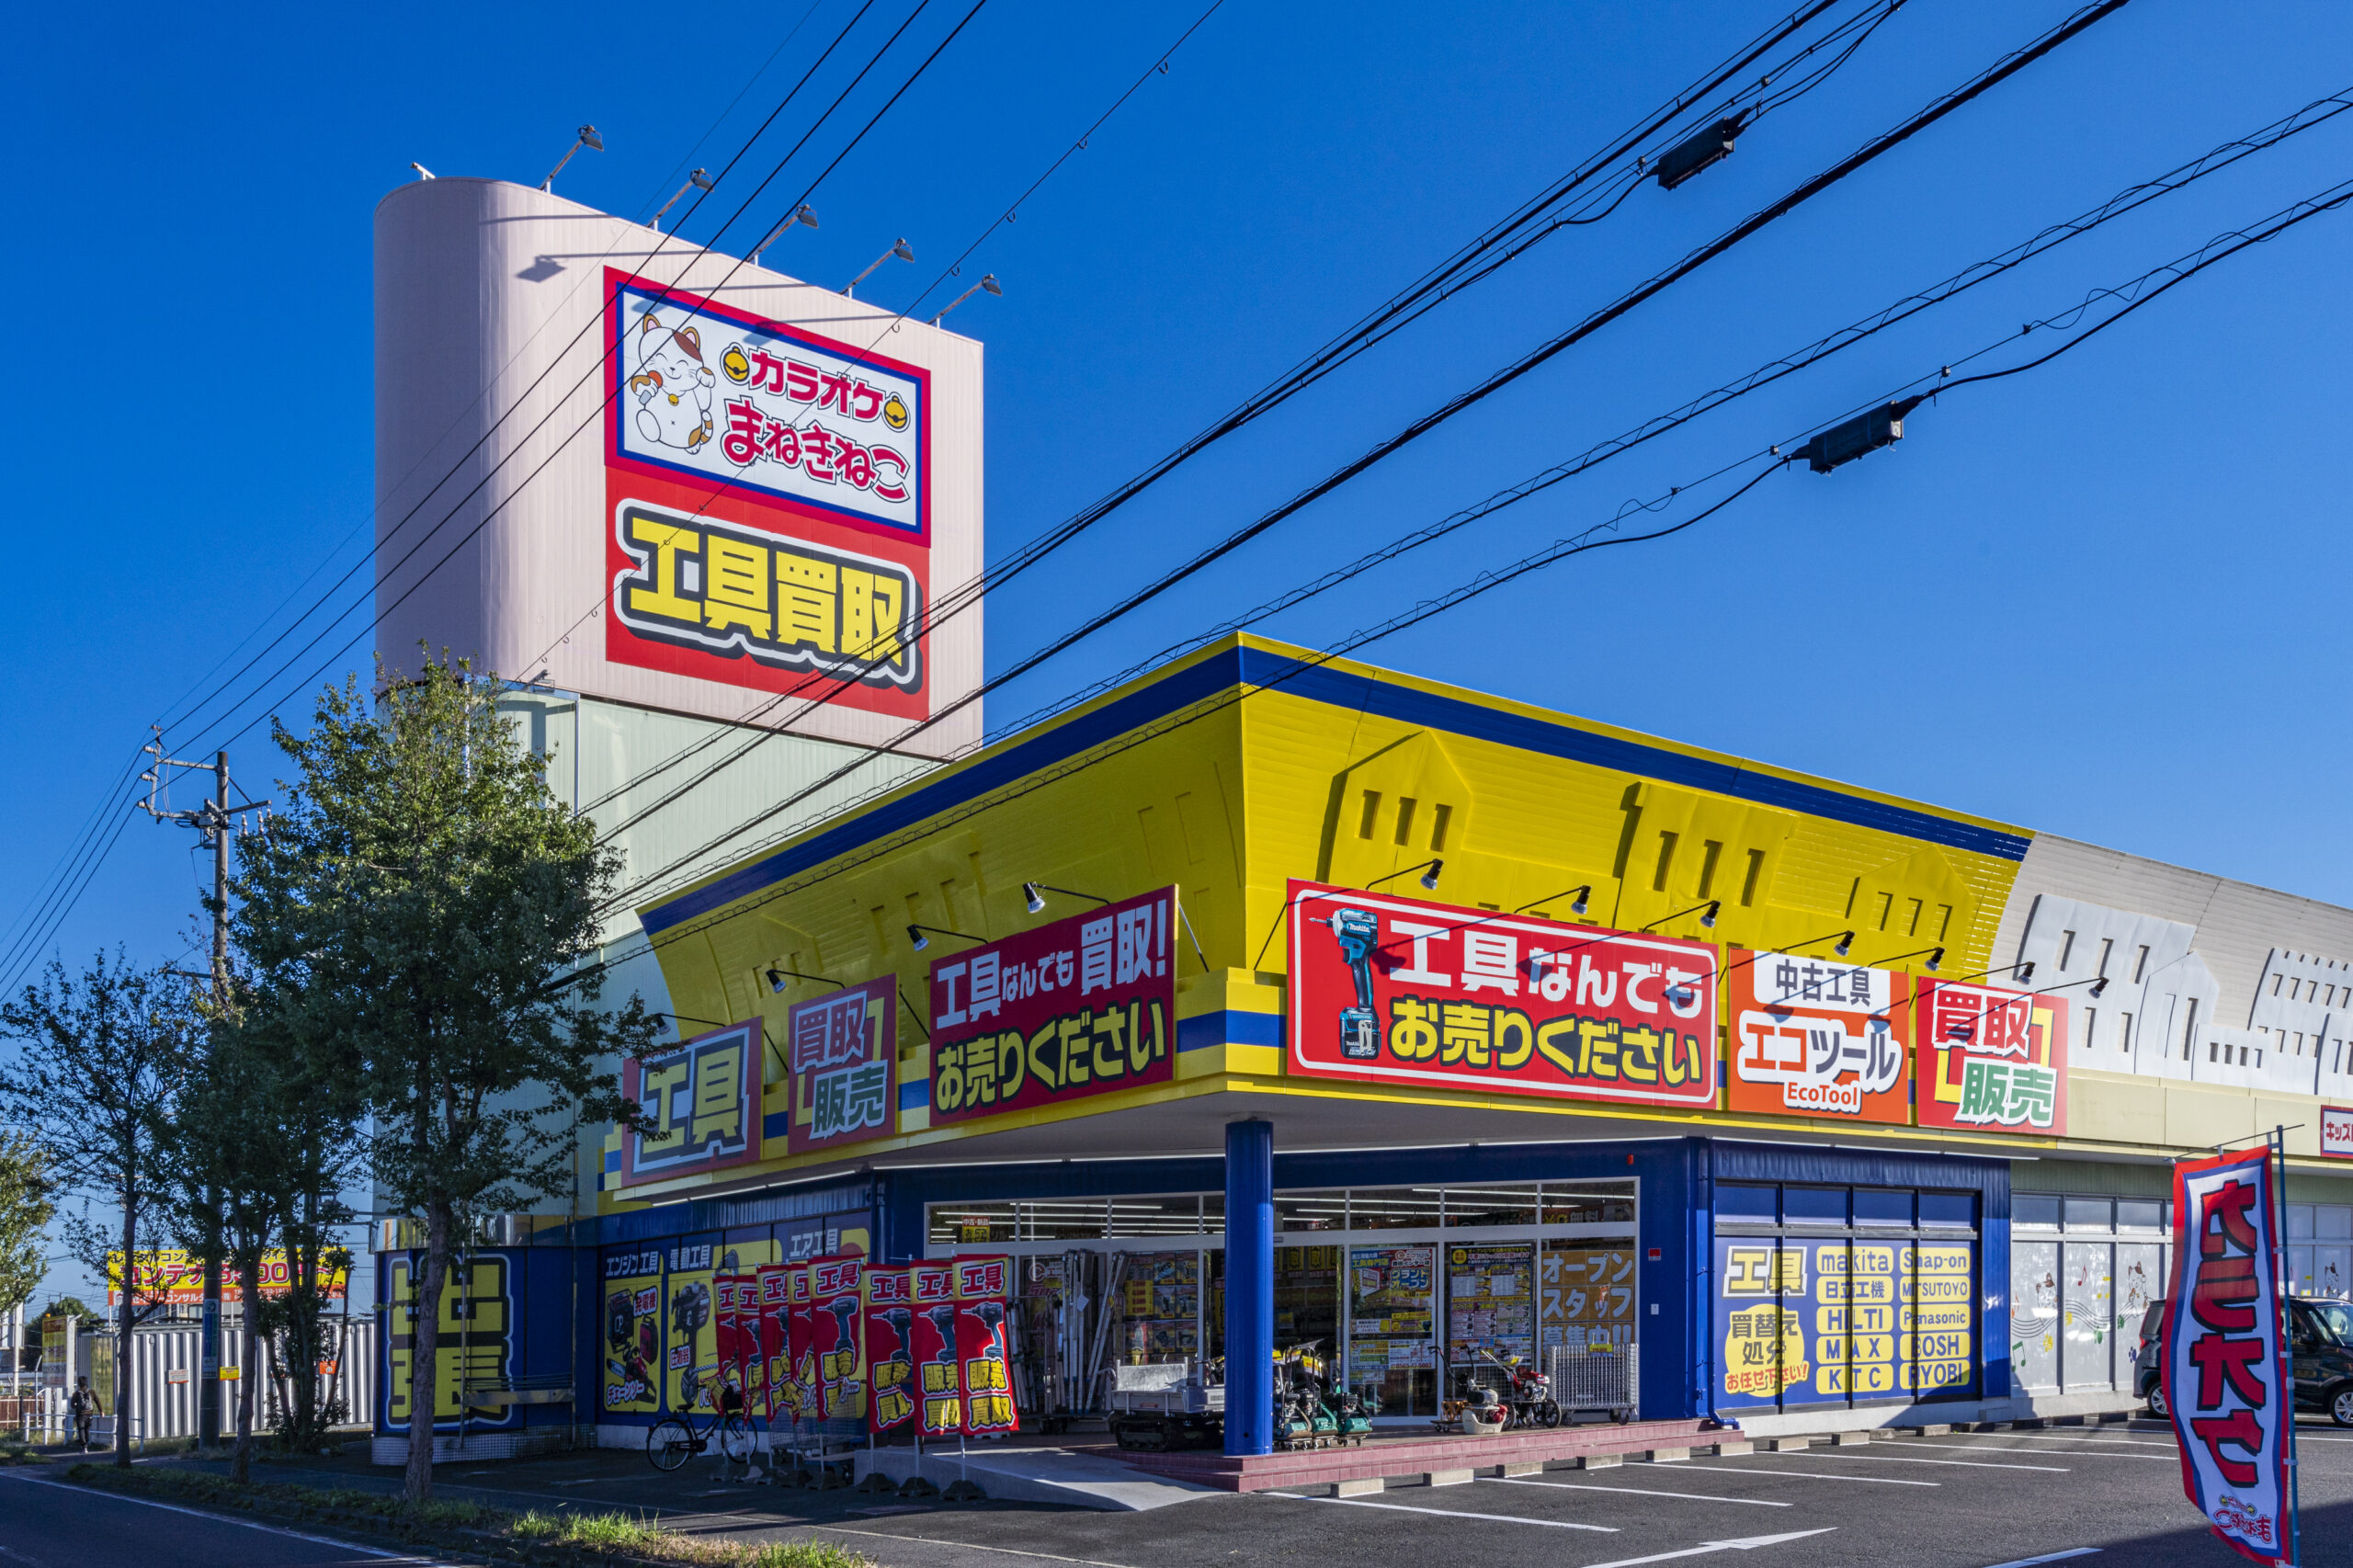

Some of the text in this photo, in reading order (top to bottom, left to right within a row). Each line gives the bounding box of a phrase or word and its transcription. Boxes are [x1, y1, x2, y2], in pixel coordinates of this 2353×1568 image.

[748, 349, 885, 420] カラオケ
[722, 397, 910, 503] まねきねこ
[629, 517, 904, 669] 工具買取
[1389, 919, 1703, 1018] 工具なんでも
[1775, 958, 1871, 1008] 中古工具
[797, 994, 867, 1069] 買取
[1933, 988, 2032, 1055] 買取
[936, 1002, 1165, 1110] お売りください
[1390, 997, 1702, 1086] お売りください
[1744, 1020, 1898, 1085] エコツール
[642, 1044, 741, 1154] 工具
[813, 1062, 887, 1135] 販売
[1787, 1082, 1859, 1107] EcoTool
[1961, 1062, 2057, 1125] 販売
[2325, 1120, 2353, 1142] キッズ
[669, 1244, 711, 1270] 電動工具
[789, 1228, 839, 1257] エア工具
[605, 1250, 660, 1276] エンジン工具
[1542, 1252, 1633, 1284] オープン
[1729, 1251, 1802, 1292] 工具
[1821, 1248, 1890, 1272] makita
[1904, 1251, 1967, 1271] Snap-on
[816, 1262, 859, 1295] 工具
[961, 1263, 1004, 1295] 工具
[1825, 1280, 1885, 1300] 日立工機
[1541, 1287, 1632, 1319] スタッフ
[1904, 1310, 1966, 1325] Panasonic
[1731, 1312, 1799, 1339] 買替え
[1827, 1308, 1883, 1331] HILTI
[1742, 1339, 1788, 1367] 処分
[1912, 1334, 1960, 1358] BOSH
[968, 1358, 1007, 1392] 販売
[1725, 1362, 1809, 1392] お任せ下さい!
[1908, 1362, 1962, 1387] RYOBI
[970, 1394, 1015, 1429] 買取
